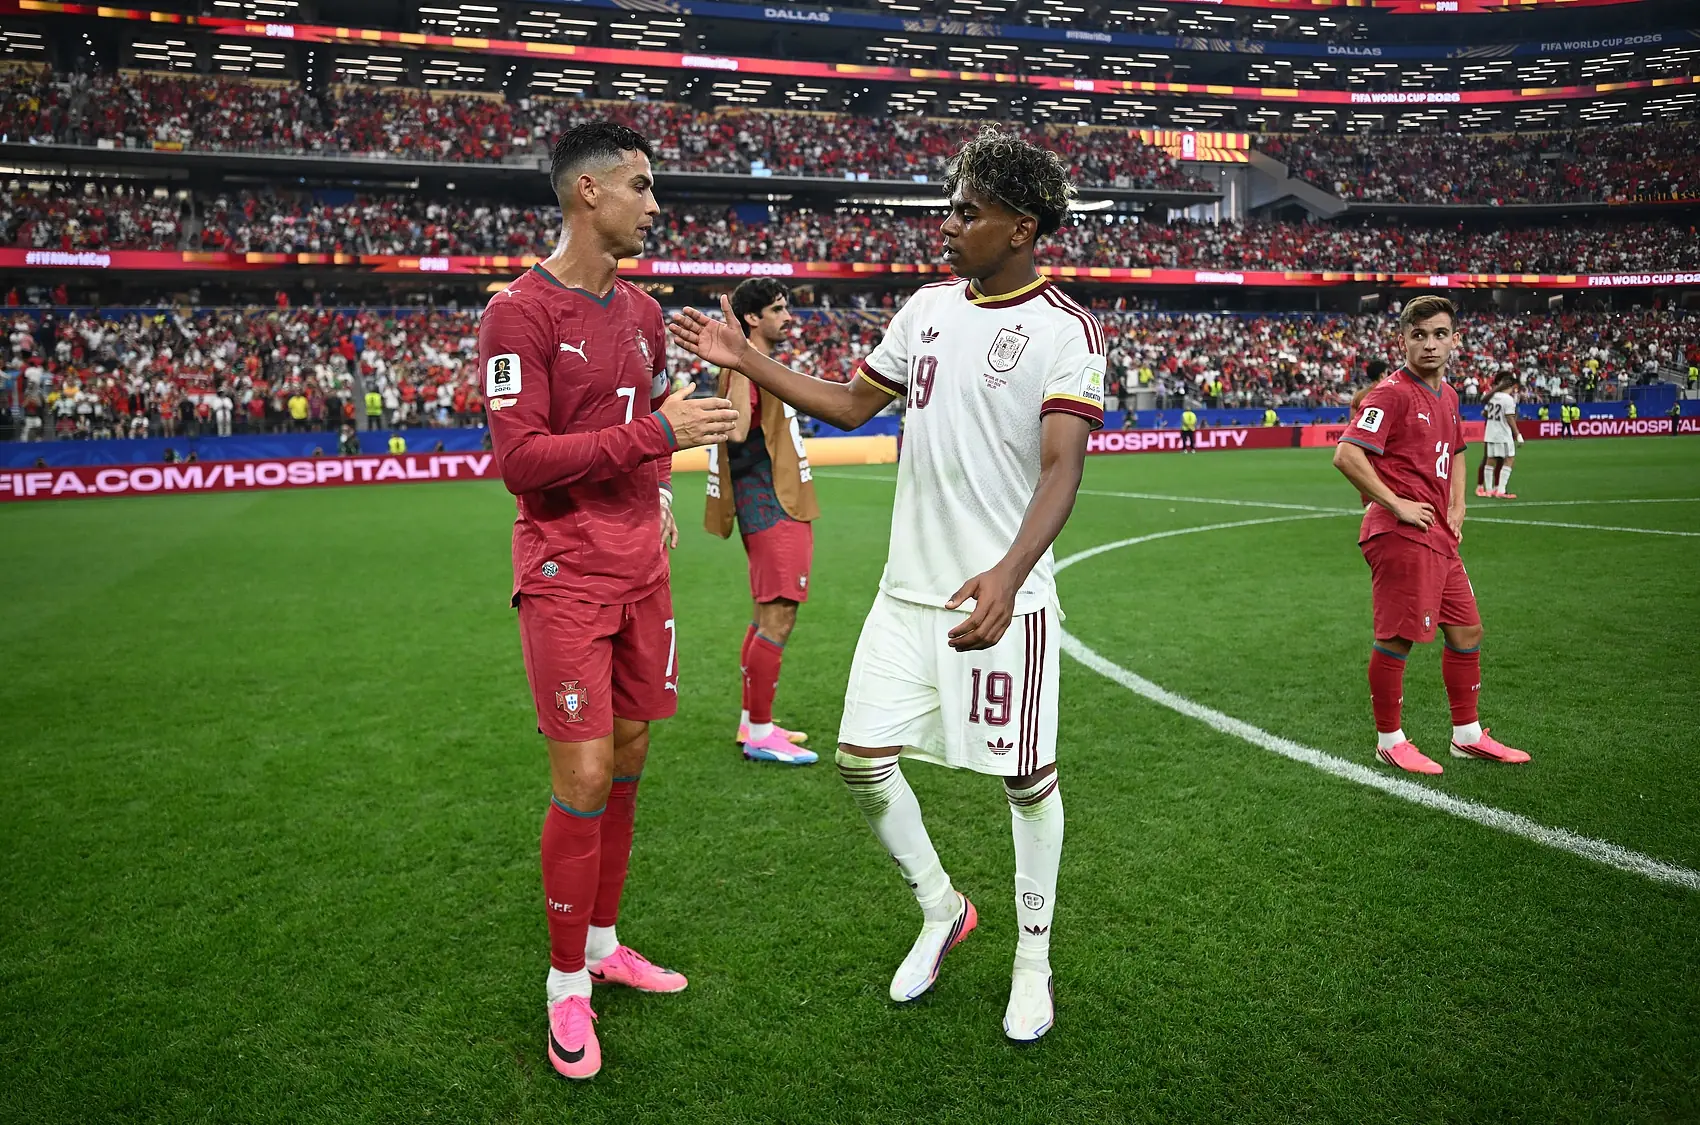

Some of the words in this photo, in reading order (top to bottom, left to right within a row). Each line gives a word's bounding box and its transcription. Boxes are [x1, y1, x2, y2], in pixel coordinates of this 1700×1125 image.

[764, 8, 830, 22] DALLAS
[1541, 43, 1562, 51] FIFA
[1563, 39, 1600, 50] WORLD
[1601, 38, 1623, 47] CUP
[1624, 33, 1662, 45] 2026
[1327, 46, 1382, 56] DALLAS
[1351, 92, 1371, 103] FIFA
[1371, 92, 1408, 103] WORLD
[1409, 92, 1426, 102] CUP
[1427, 92, 1461, 102] 2026
[652, 261, 680, 274] FIFA
[680, 261, 725, 275] WORLD
[725, 262, 750, 275] CUP
[750, 263, 794, 275] 2026
[1588, 276, 1612, 286] FIFA
[1612, 275, 1651, 285] WORLD
[1651, 274, 1674, 284] CUP
[616, 386, 636, 424] 7
[1488, 403, 1502, 421] 22
[664, 618, 676, 677] 7
[968, 667, 1014, 727] 19
